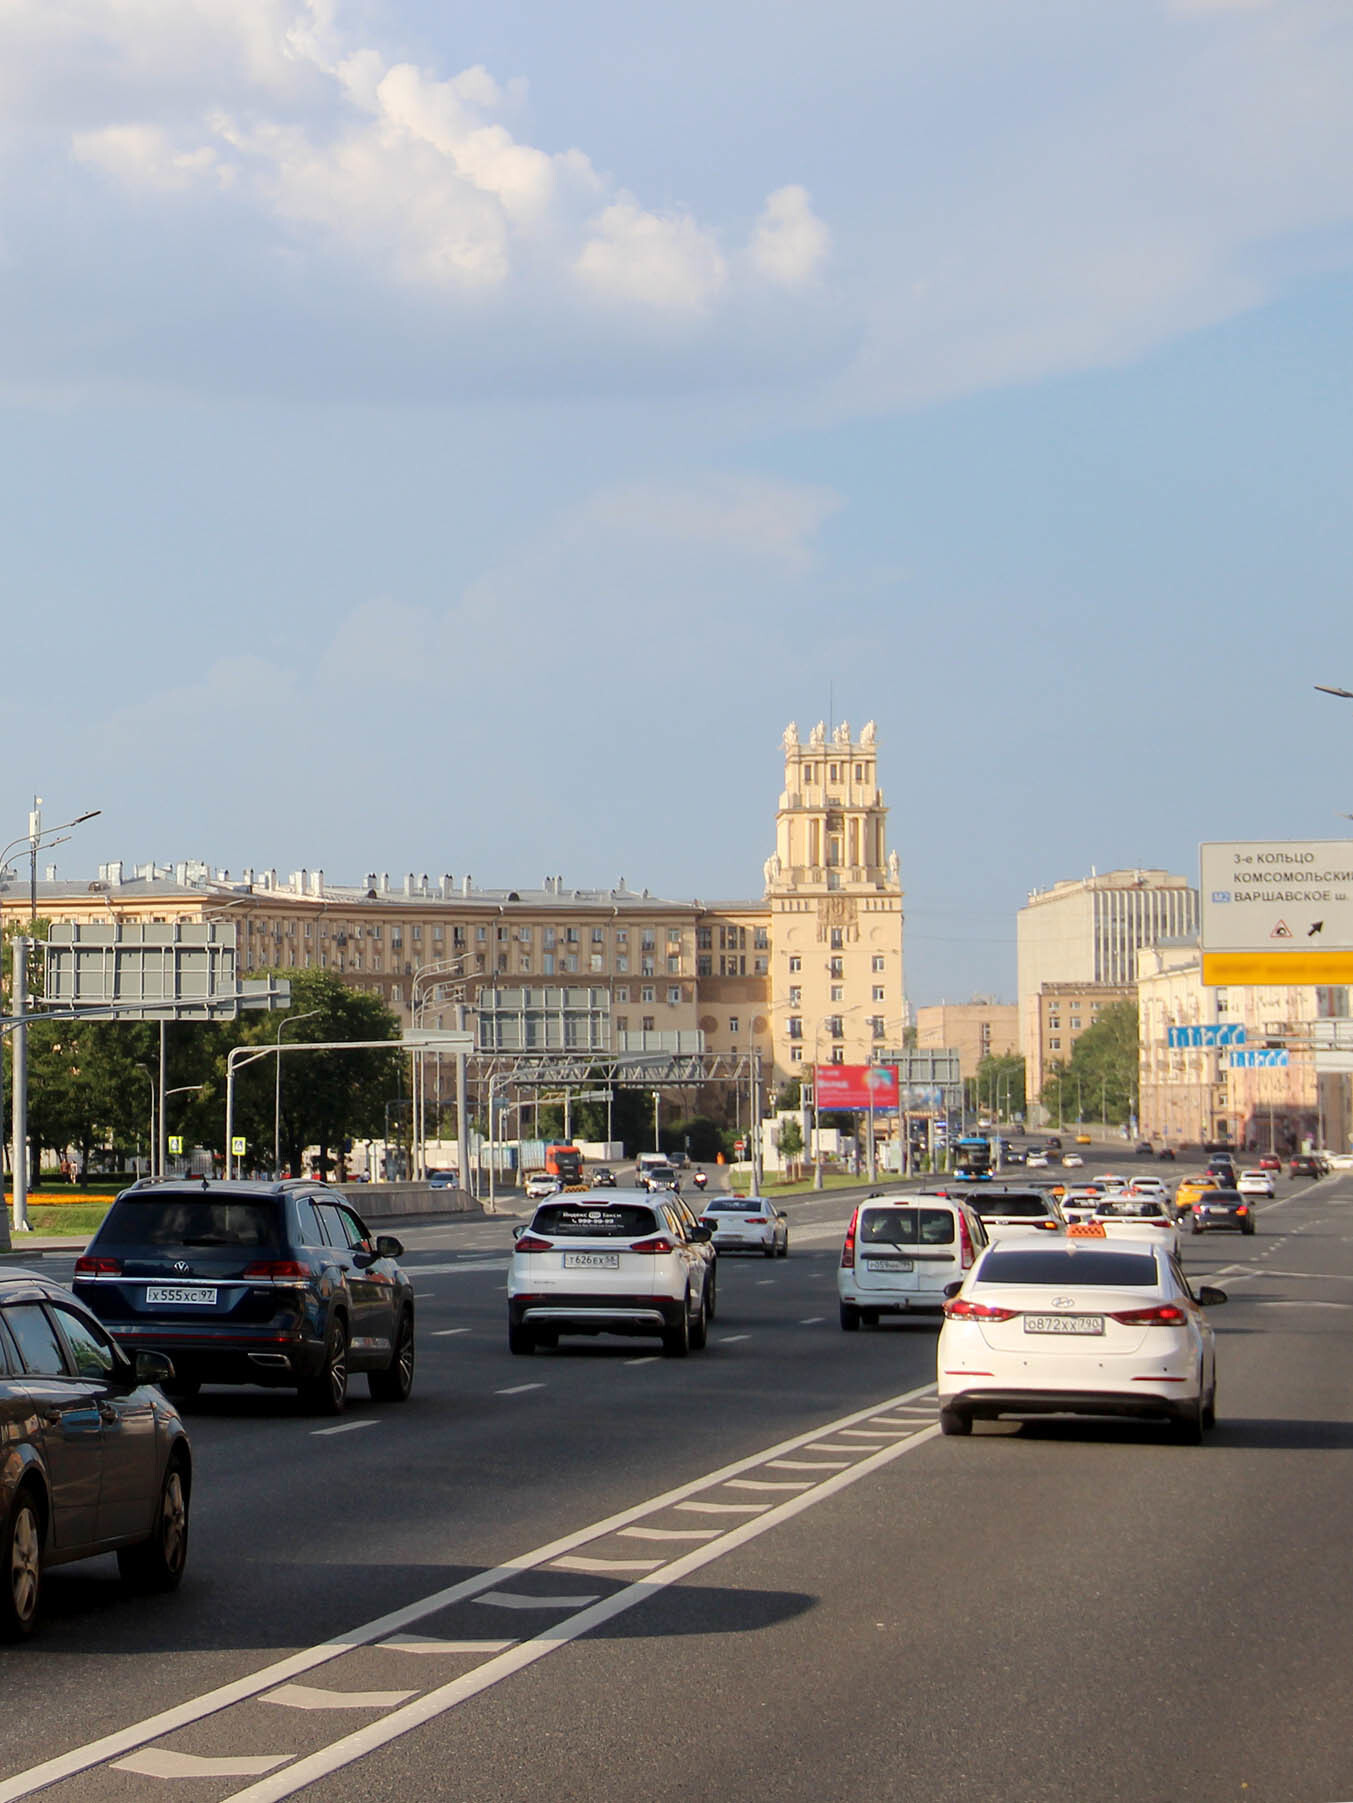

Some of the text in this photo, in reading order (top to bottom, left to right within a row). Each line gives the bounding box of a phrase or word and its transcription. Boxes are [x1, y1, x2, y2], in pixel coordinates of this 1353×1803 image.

[1233, 852, 1315, 865] 3-е КОЛЬЦО
[1233, 871, 1353, 883] КОМСОМОЛЬСКИ
[1233, 890, 1331, 902] ВАРШАВСКОЕ
[152, 1289, 213, 1302] Х555ХС 97
[1027, 1318, 1077, 1330] О872ХХ
